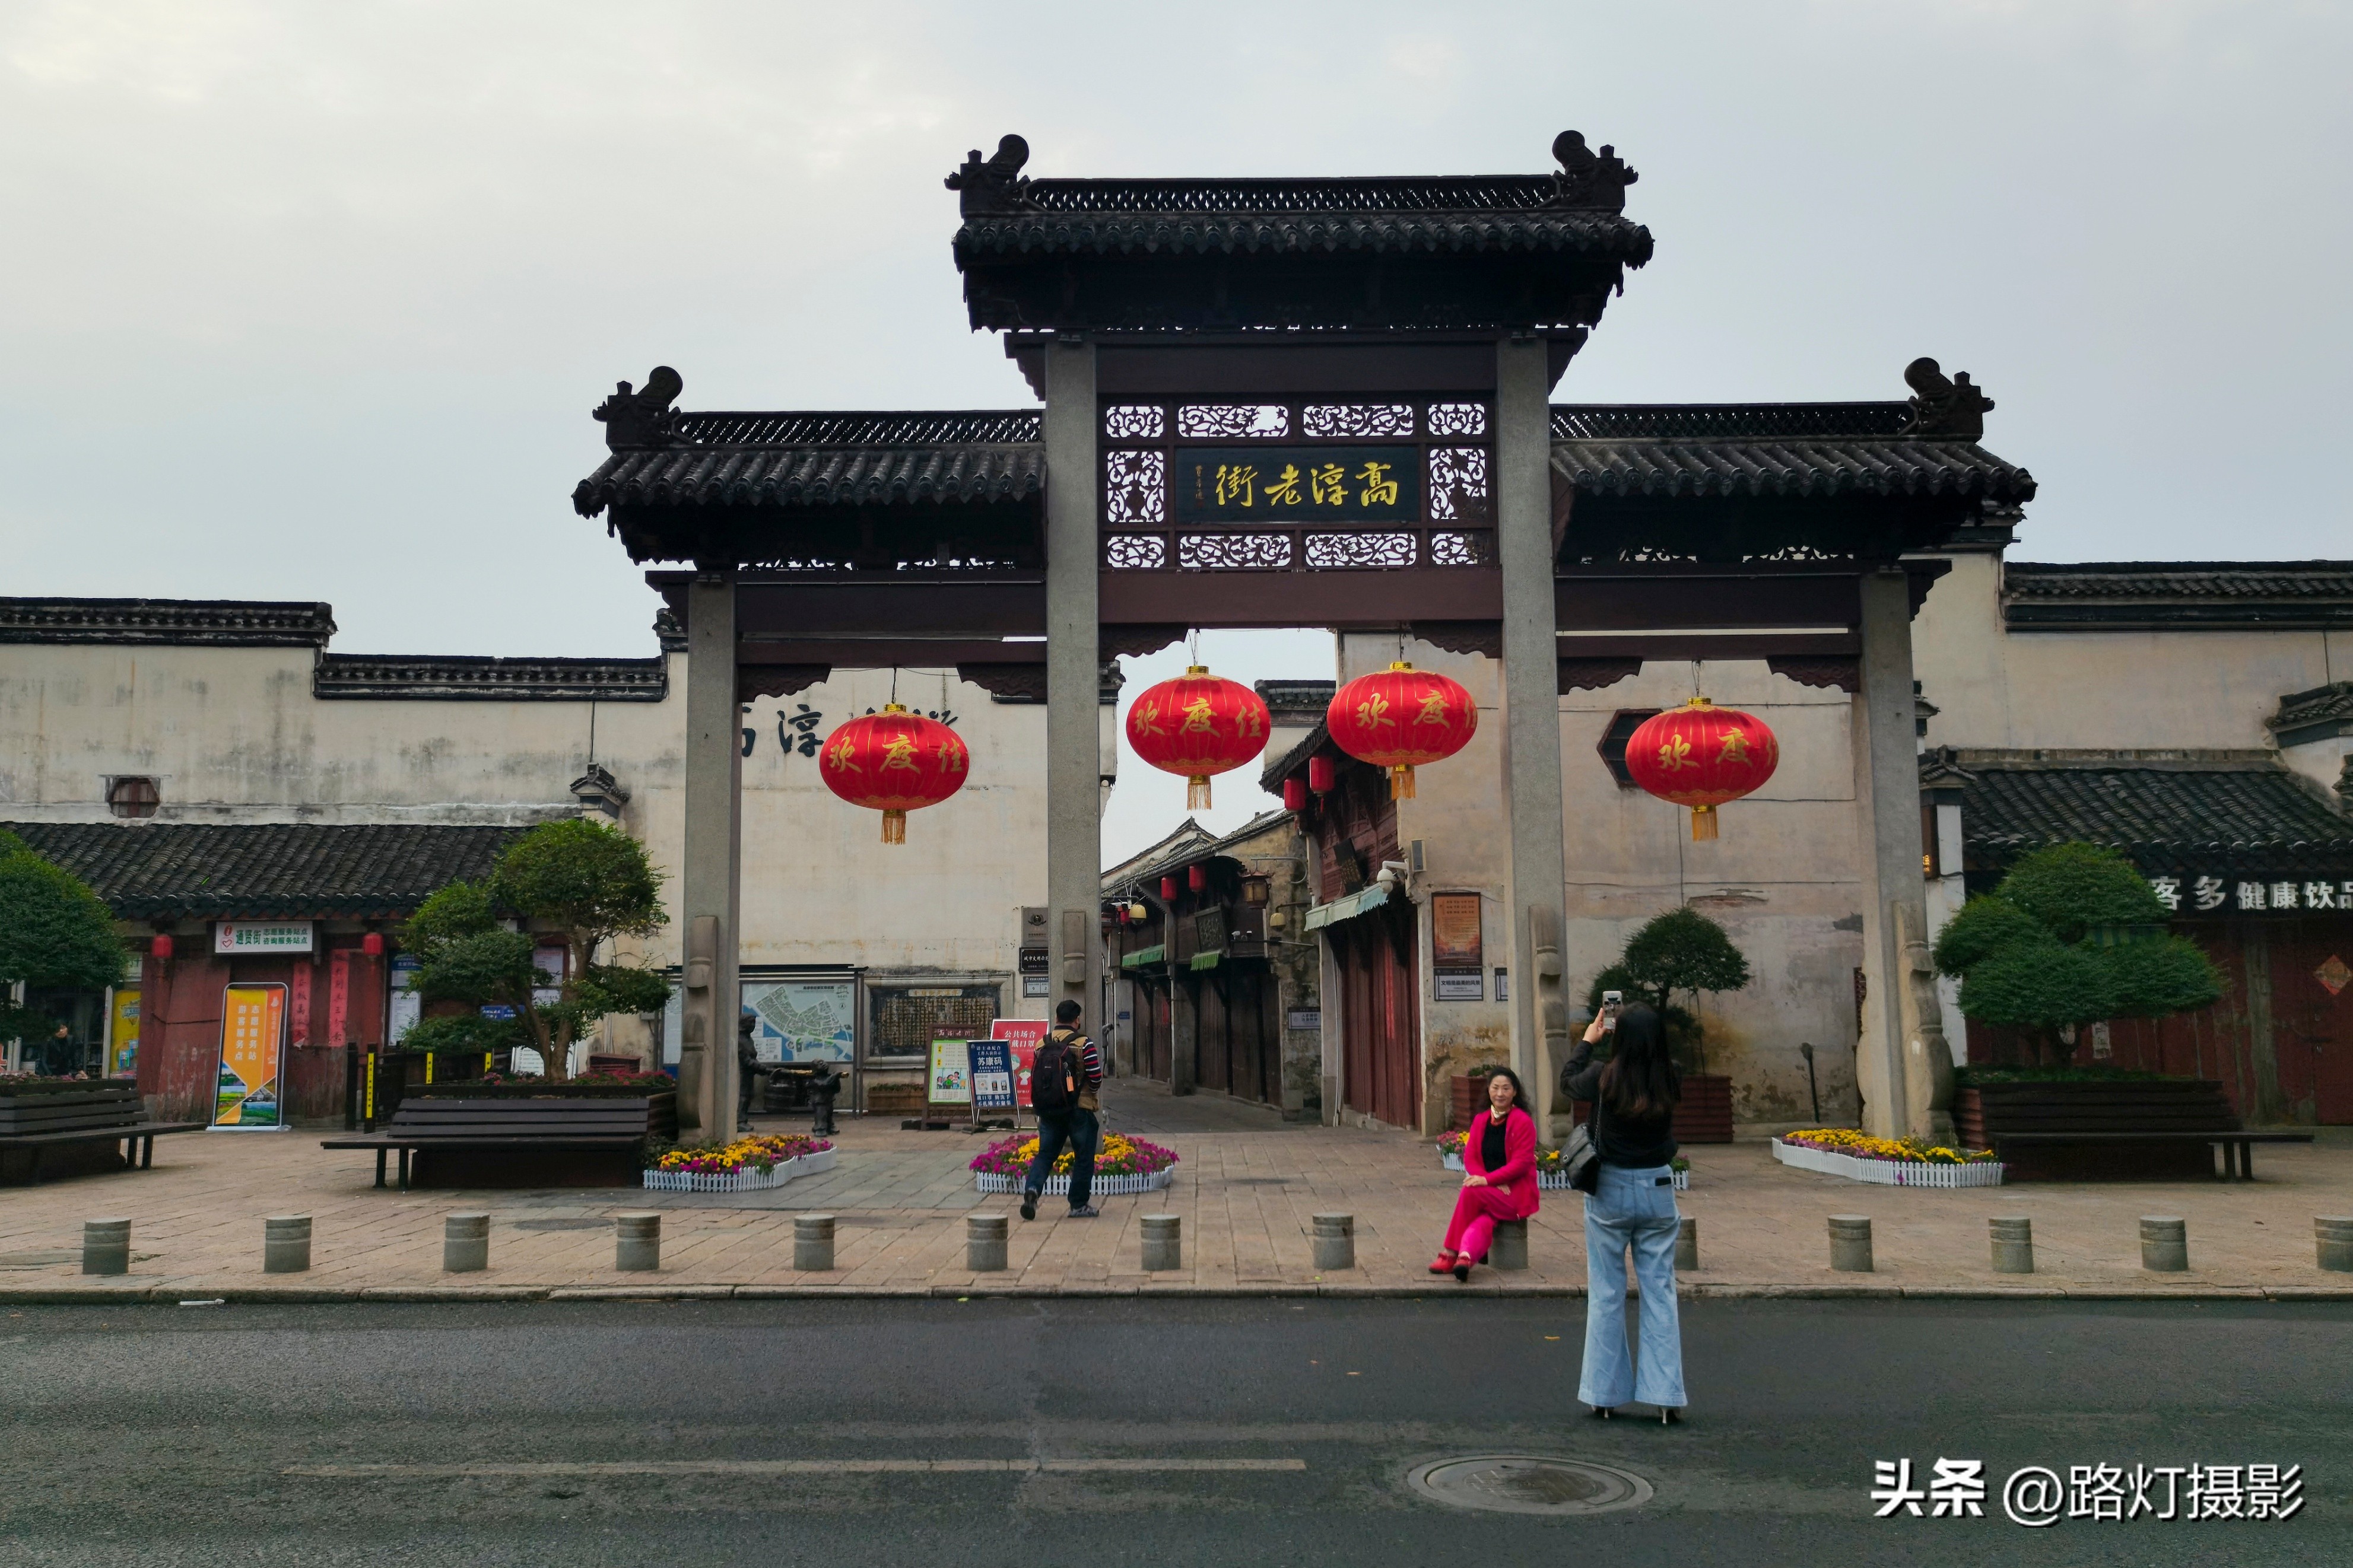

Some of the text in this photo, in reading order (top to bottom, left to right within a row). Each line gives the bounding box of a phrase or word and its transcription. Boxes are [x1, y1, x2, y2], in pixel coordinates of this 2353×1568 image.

[1215, 462, 1398, 507] 高淳老街
[1134, 696, 1262, 739] 欢度佳
[828, 733, 963, 775] 欢度佳
[1005, 1030, 1036, 1038] 公共场合
[1009, 1039, 1035, 1048] 戴口罩
[977, 1056, 1002, 1066] 苏康码
